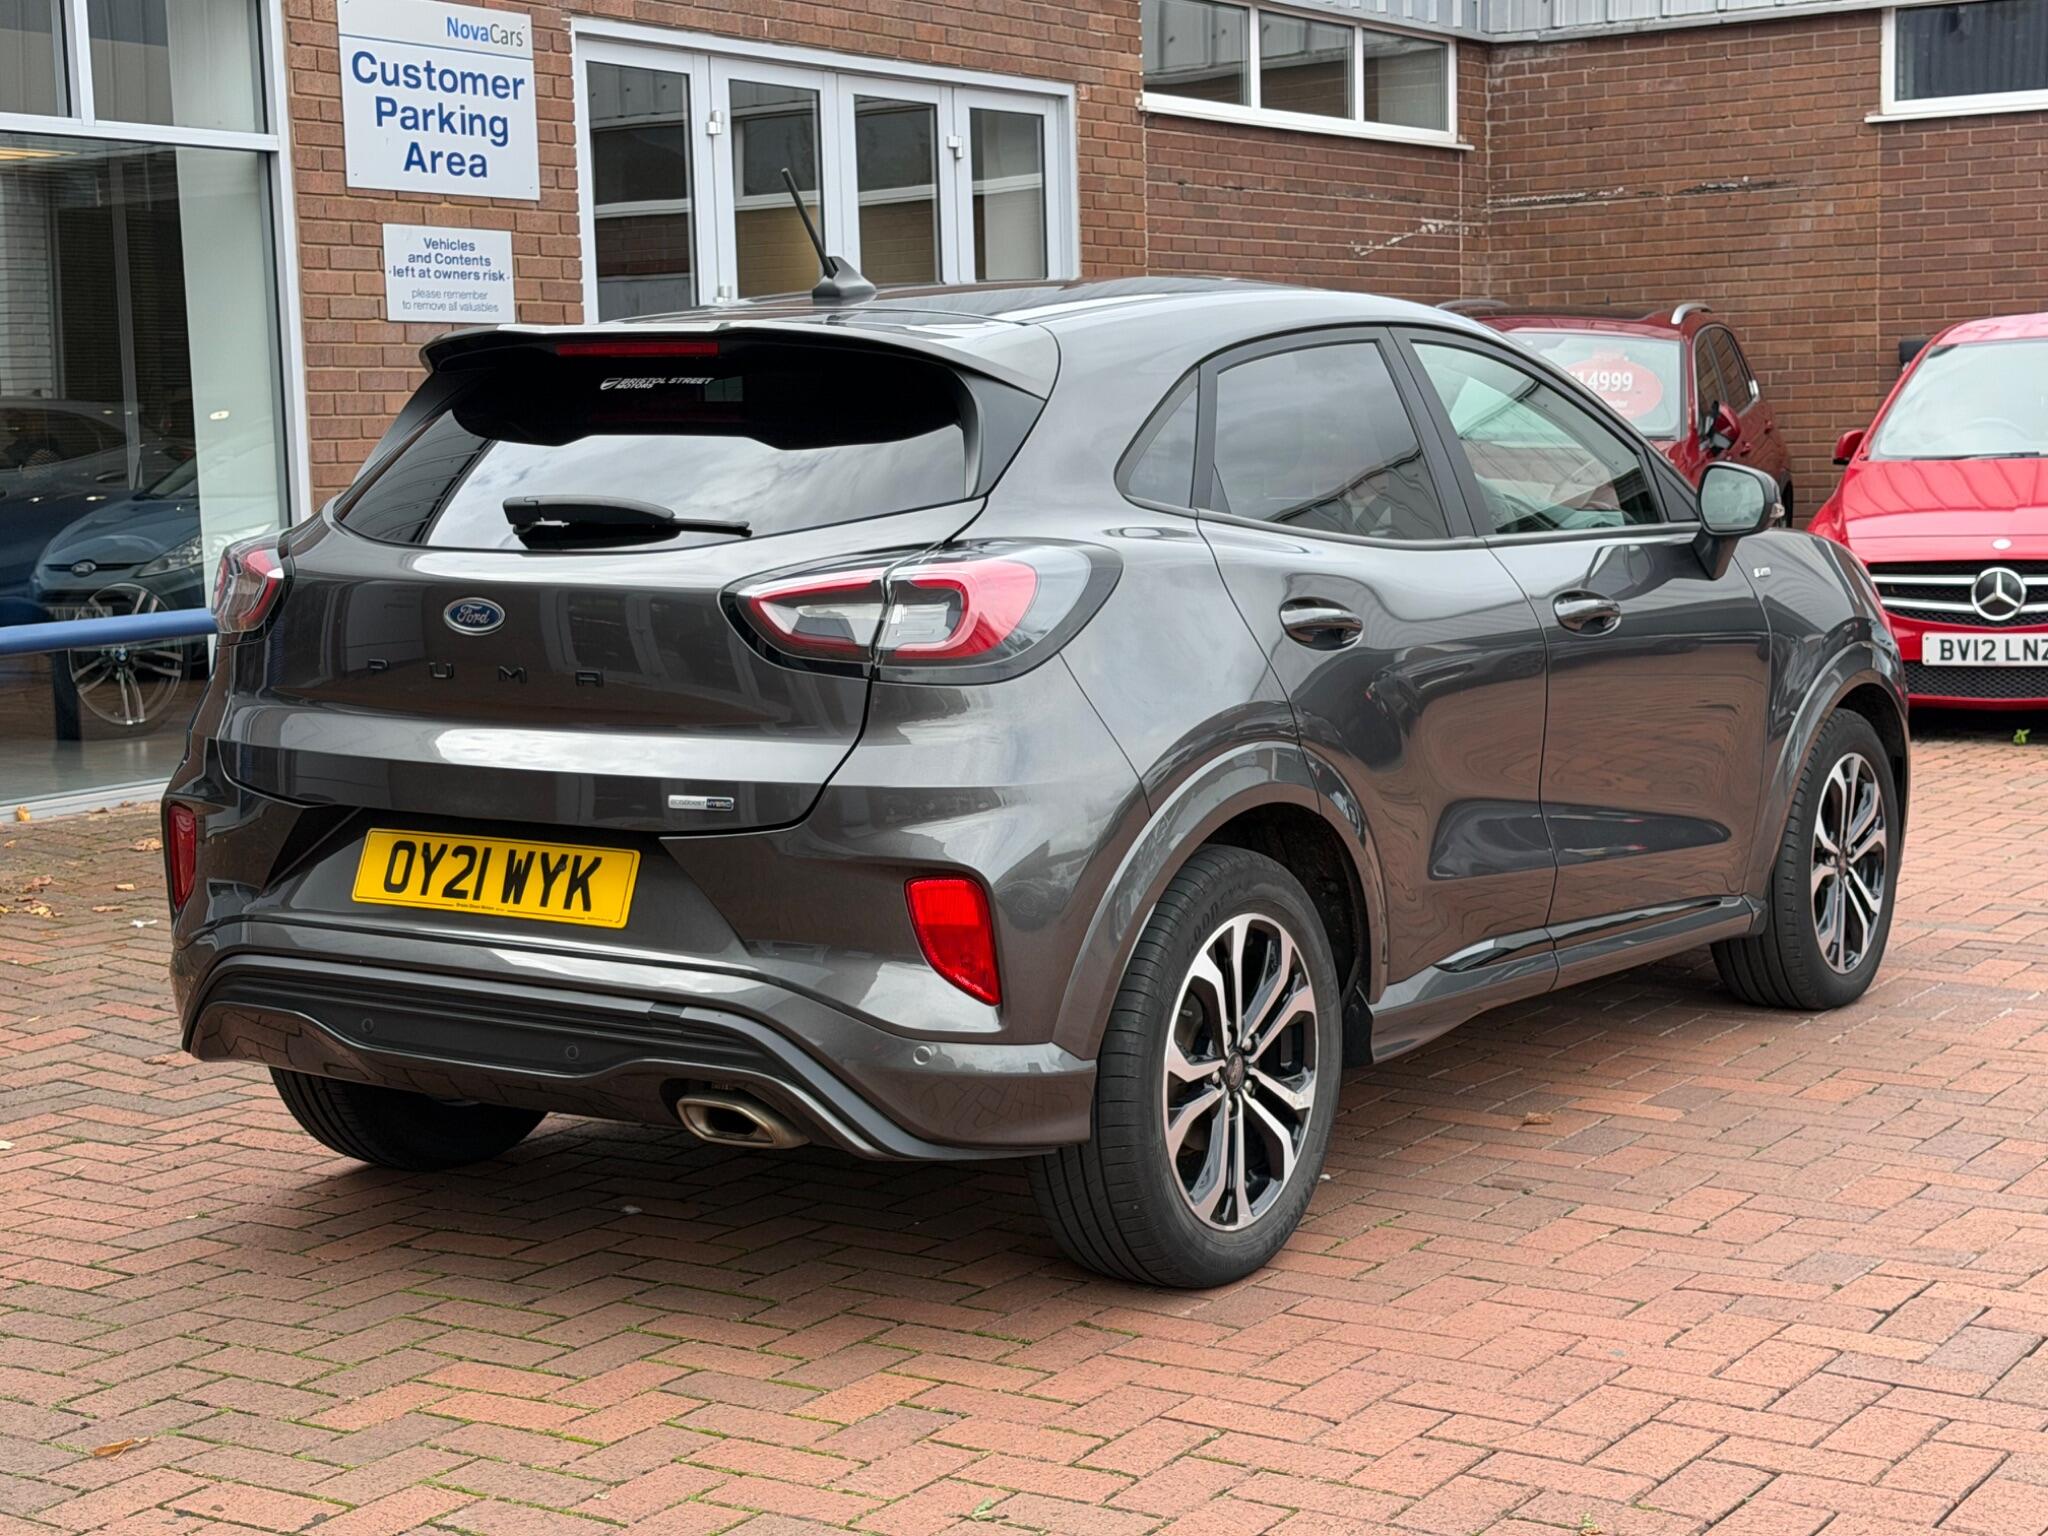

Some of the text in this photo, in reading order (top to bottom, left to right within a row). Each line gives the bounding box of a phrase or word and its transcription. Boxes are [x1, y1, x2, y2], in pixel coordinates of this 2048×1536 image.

[446, 16, 523, 47] NovaCars
[351, 51, 526, 100] Customer
[375, 96, 509, 147] Parking
[403, 142, 488, 178] Area
[423, 238, 476, 252] Vehicles
[407, 253, 492, 267] and Contents
[392, 265, 506, 282] left at owners risk
[411, 288, 488, 300] please remember
[402, 300, 499, 313] to remove all valuables
[667, 377, 715, 385] STREET
[456, 604, 490, 625] Ford
[1939, 638, 1997, 662] BV12
[367, 658, 604, 688] PUMA
[383, 840, 603, 912] OY21 WYK
